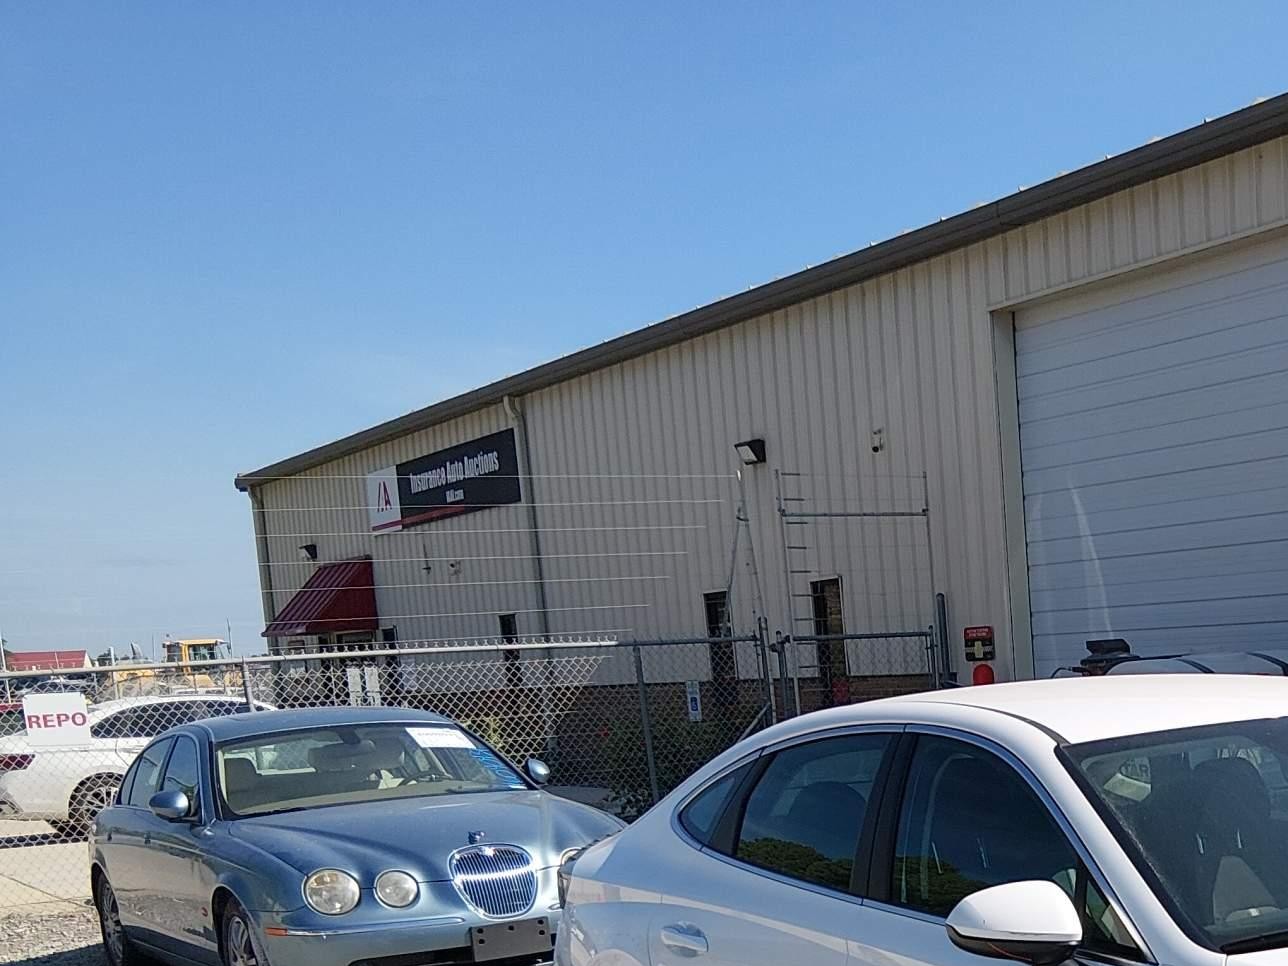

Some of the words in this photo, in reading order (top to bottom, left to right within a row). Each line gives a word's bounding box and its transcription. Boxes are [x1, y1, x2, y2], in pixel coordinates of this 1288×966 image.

[409, 466, 446, 494] Insurance
[446, 460, 464, 484] Auto
[463, 451, 499, 479] Auctions
[26, 711, 87, 729] REPO
